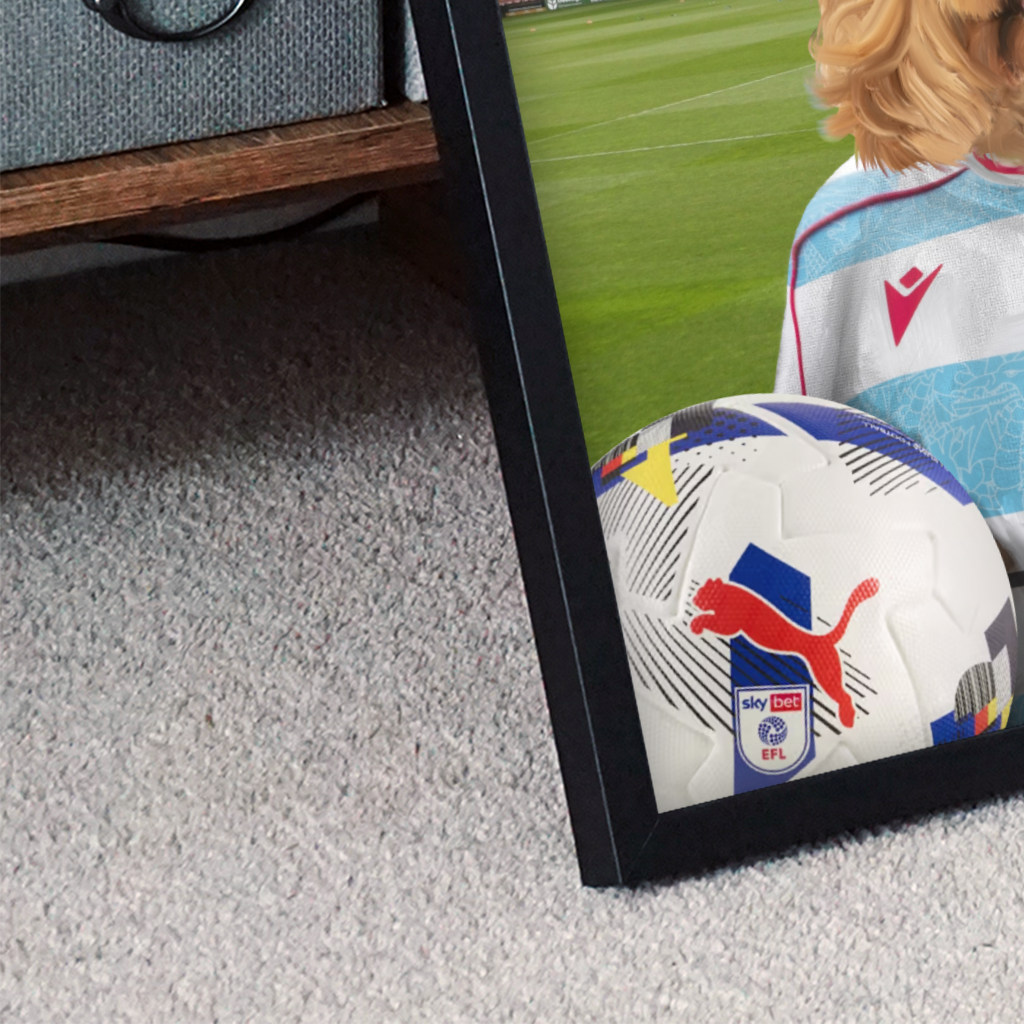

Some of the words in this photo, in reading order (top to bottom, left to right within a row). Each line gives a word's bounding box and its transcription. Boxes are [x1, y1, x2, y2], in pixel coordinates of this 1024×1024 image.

[741, 695, 768, 712] sky
[773, 694, 800, 709] bet
[761, 748, 787, 761] EFL
